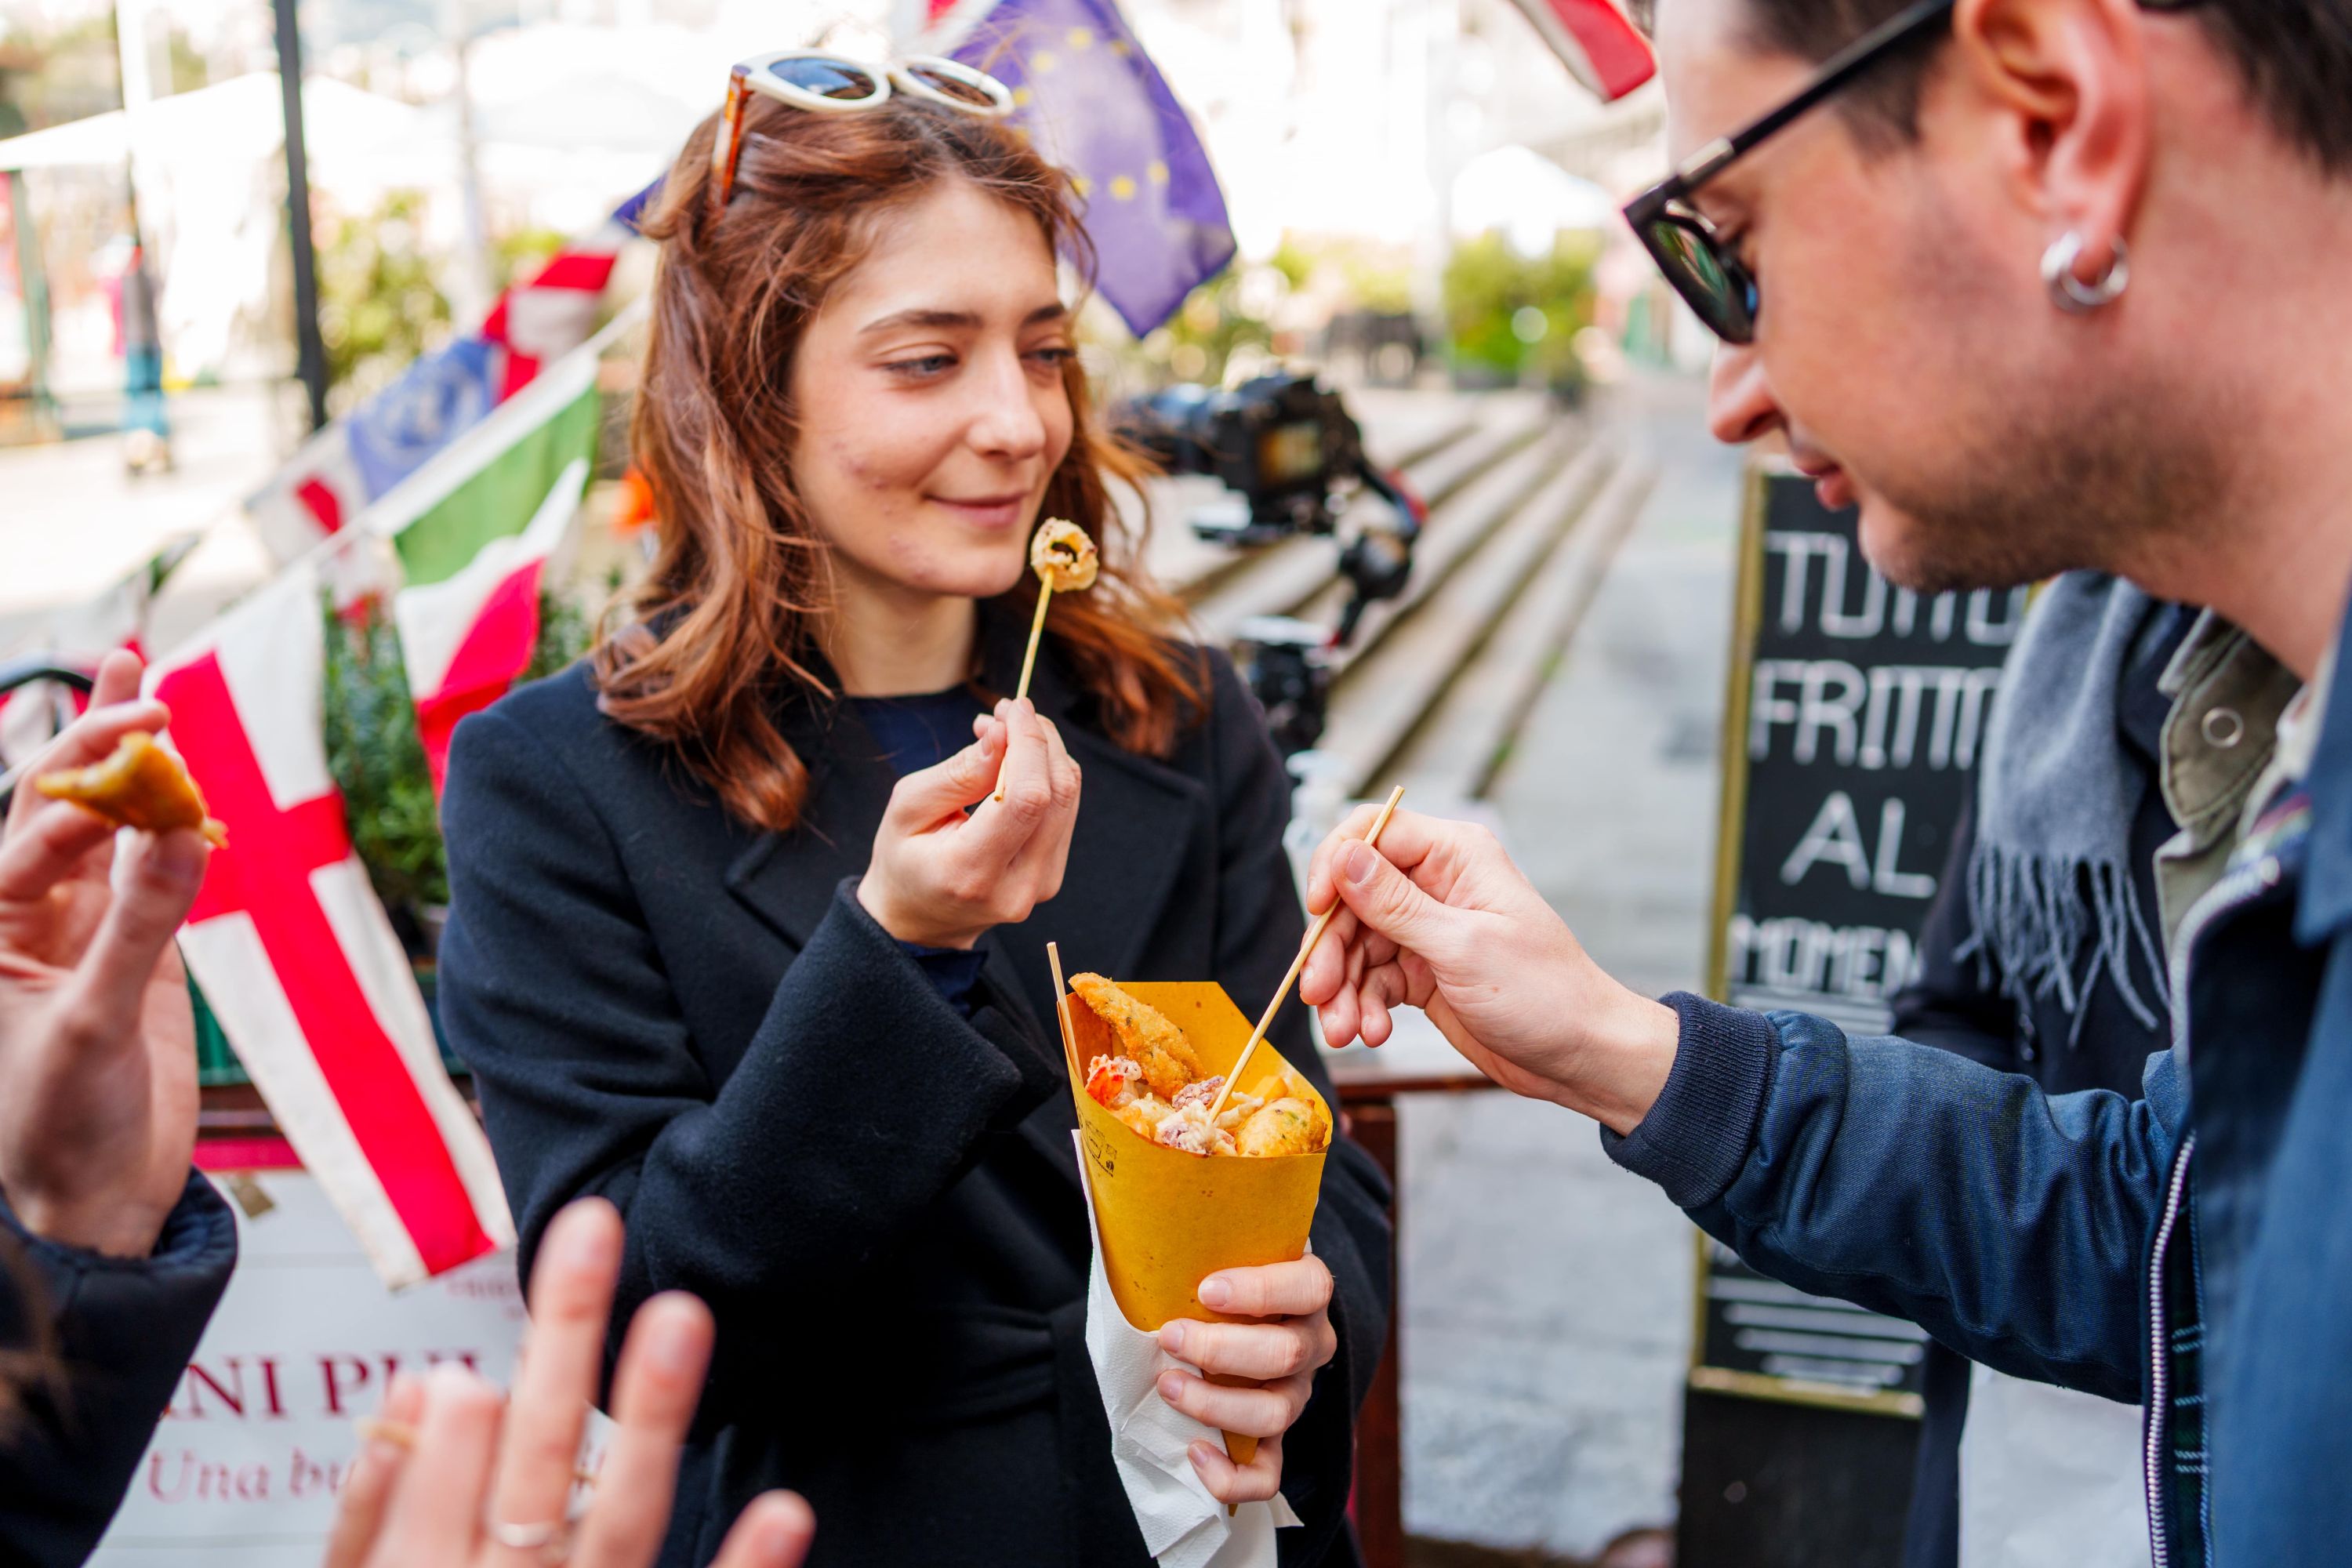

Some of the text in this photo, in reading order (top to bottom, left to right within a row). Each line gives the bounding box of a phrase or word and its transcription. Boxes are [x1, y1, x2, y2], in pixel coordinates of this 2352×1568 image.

[1780, 790, 1936, 898] AL
[1727, 914, 1926, 1002] MOMEN
[159, 1353, 299, 1421] NI
[147, 1449, 270, 1504] Una
